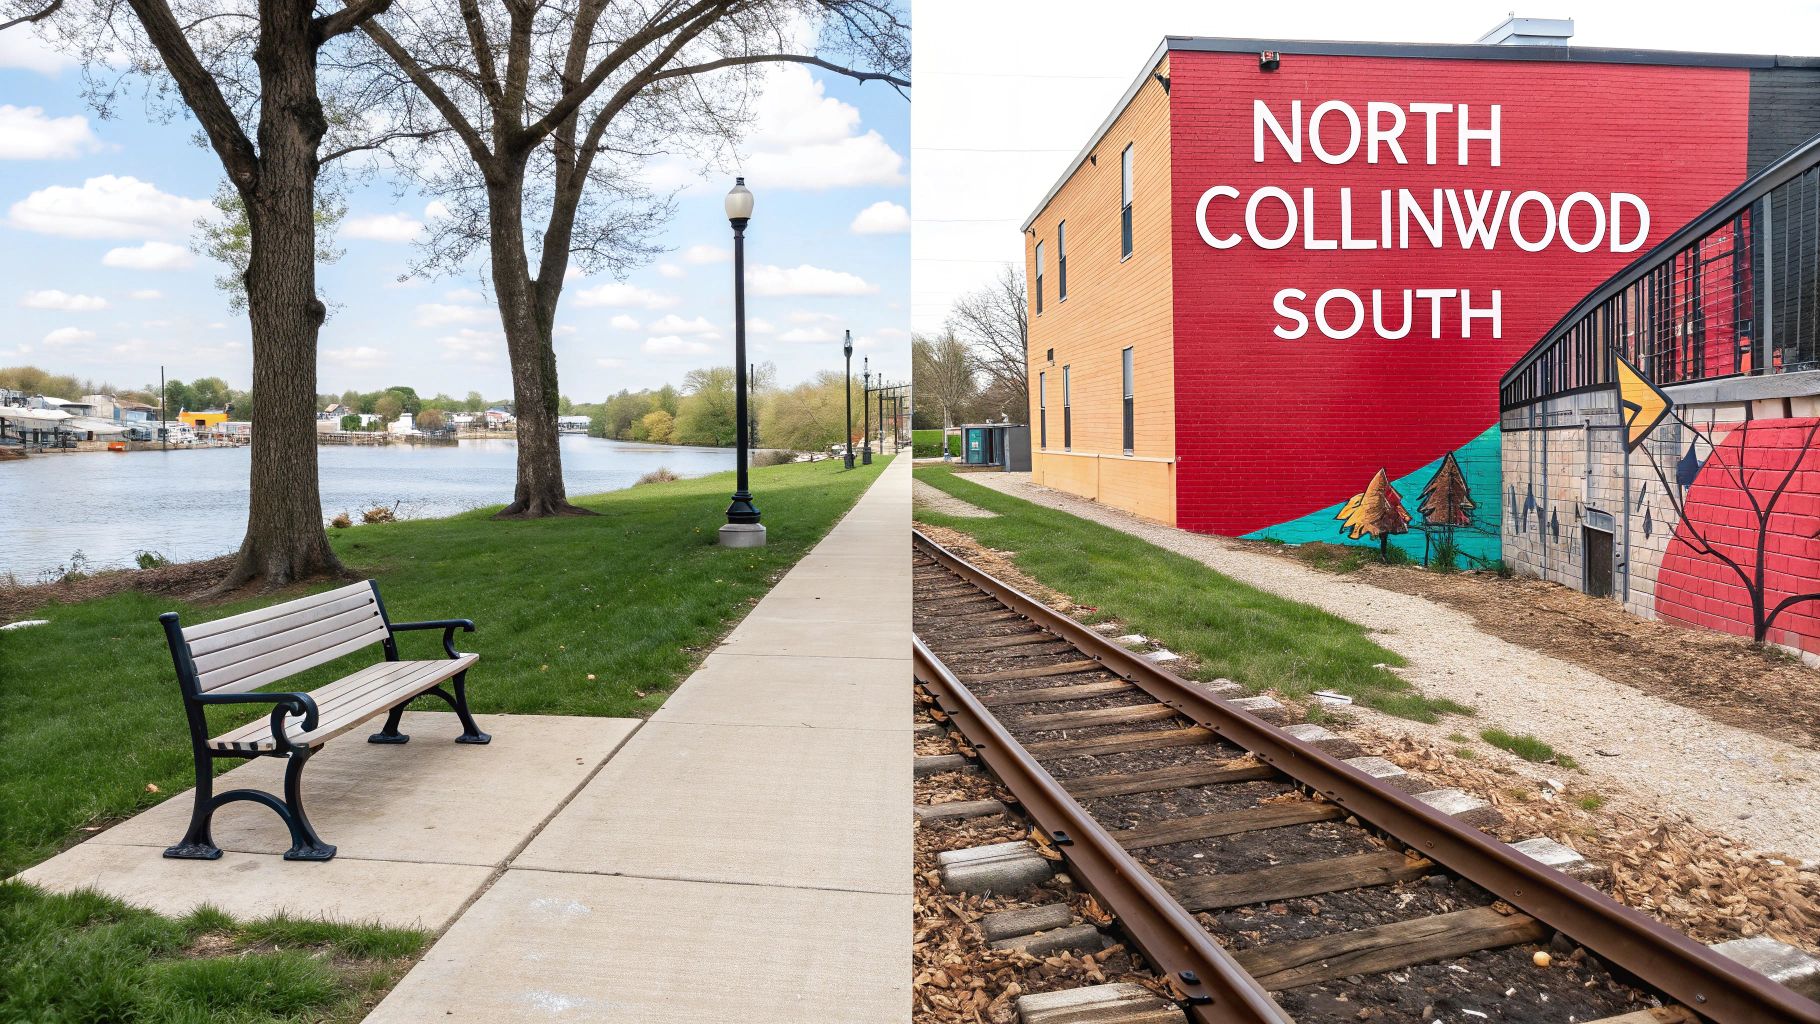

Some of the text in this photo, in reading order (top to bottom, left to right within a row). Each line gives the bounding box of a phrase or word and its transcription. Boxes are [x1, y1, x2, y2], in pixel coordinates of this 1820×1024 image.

[1253, 99, 1501, 167] NORTH
[1195, 185, 1651, 253] COLLINWOOD
[1272, 287, 1502, 340] SOUTH
